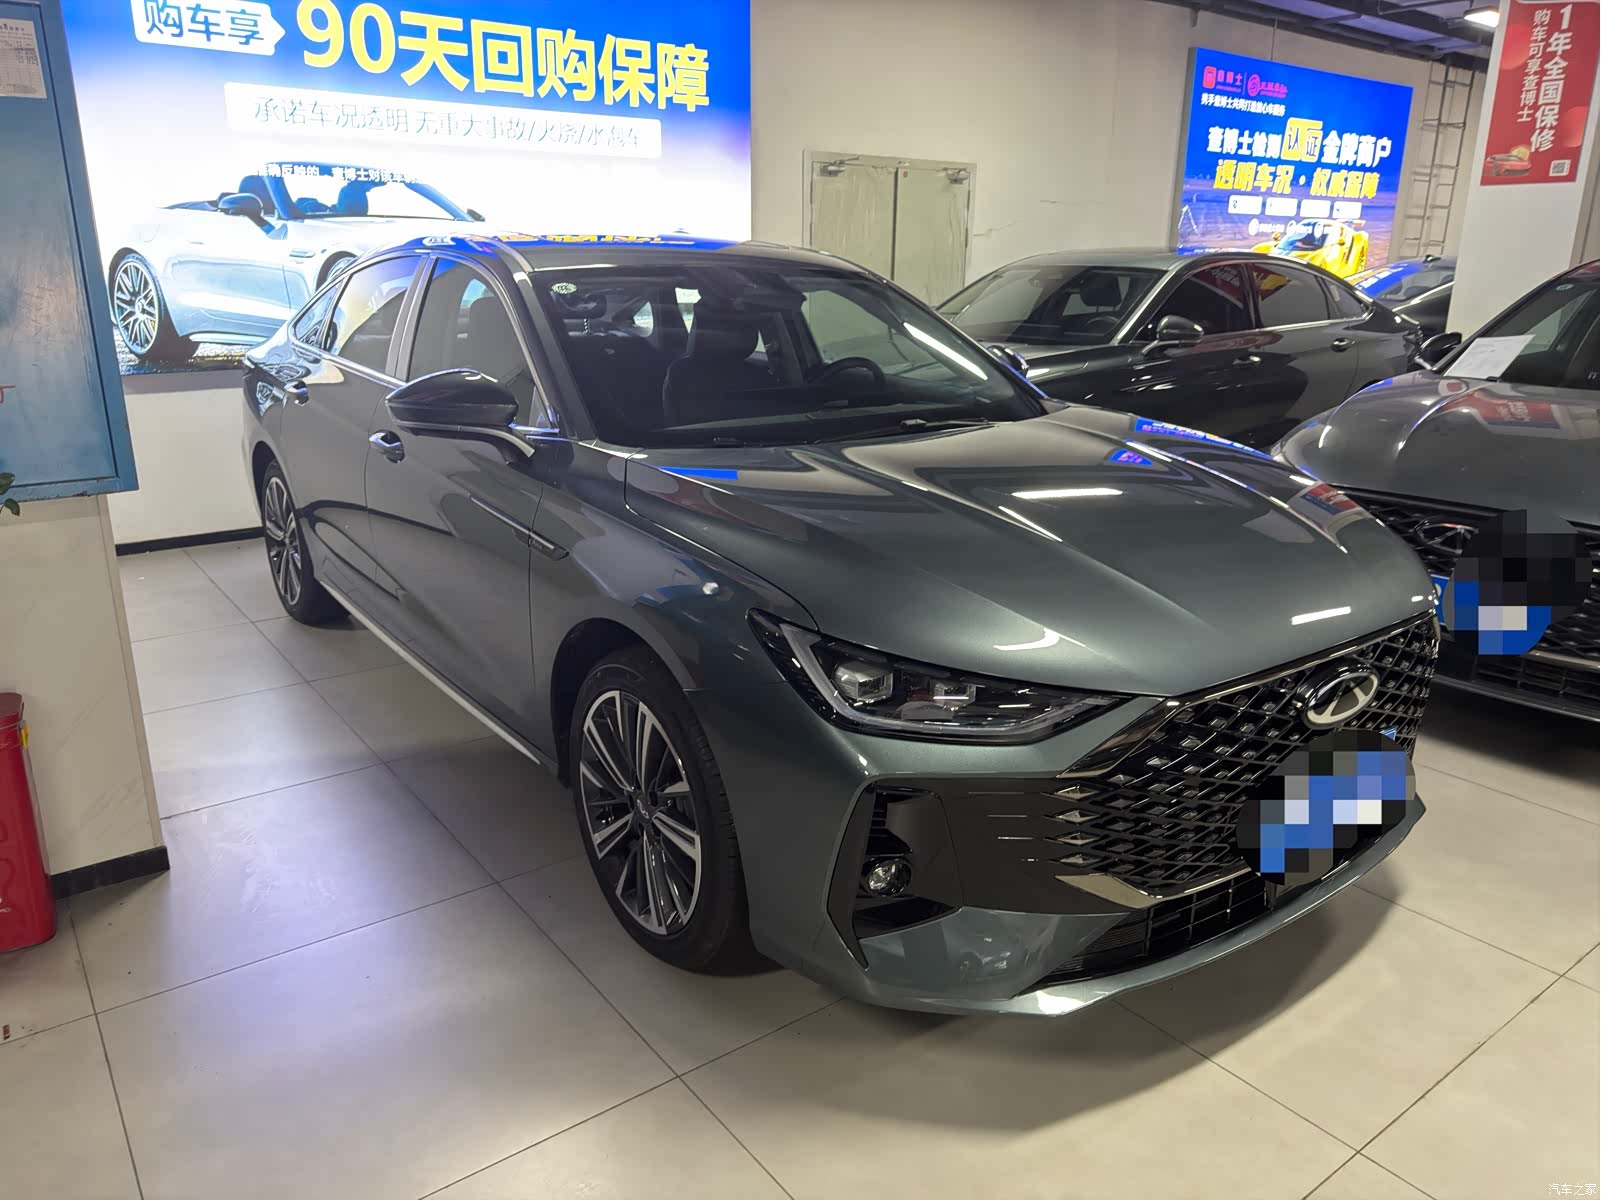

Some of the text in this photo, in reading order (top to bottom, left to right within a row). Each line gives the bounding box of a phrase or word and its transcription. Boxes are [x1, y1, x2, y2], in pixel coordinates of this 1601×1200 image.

[144, 0, 265, 46] 购车享
[296, 0, 711, 112] 90天回购保障
[1517, 9, 1552, 122] 购车可享查博士
[1530, 4, 1573, 152] 1年全国保修
